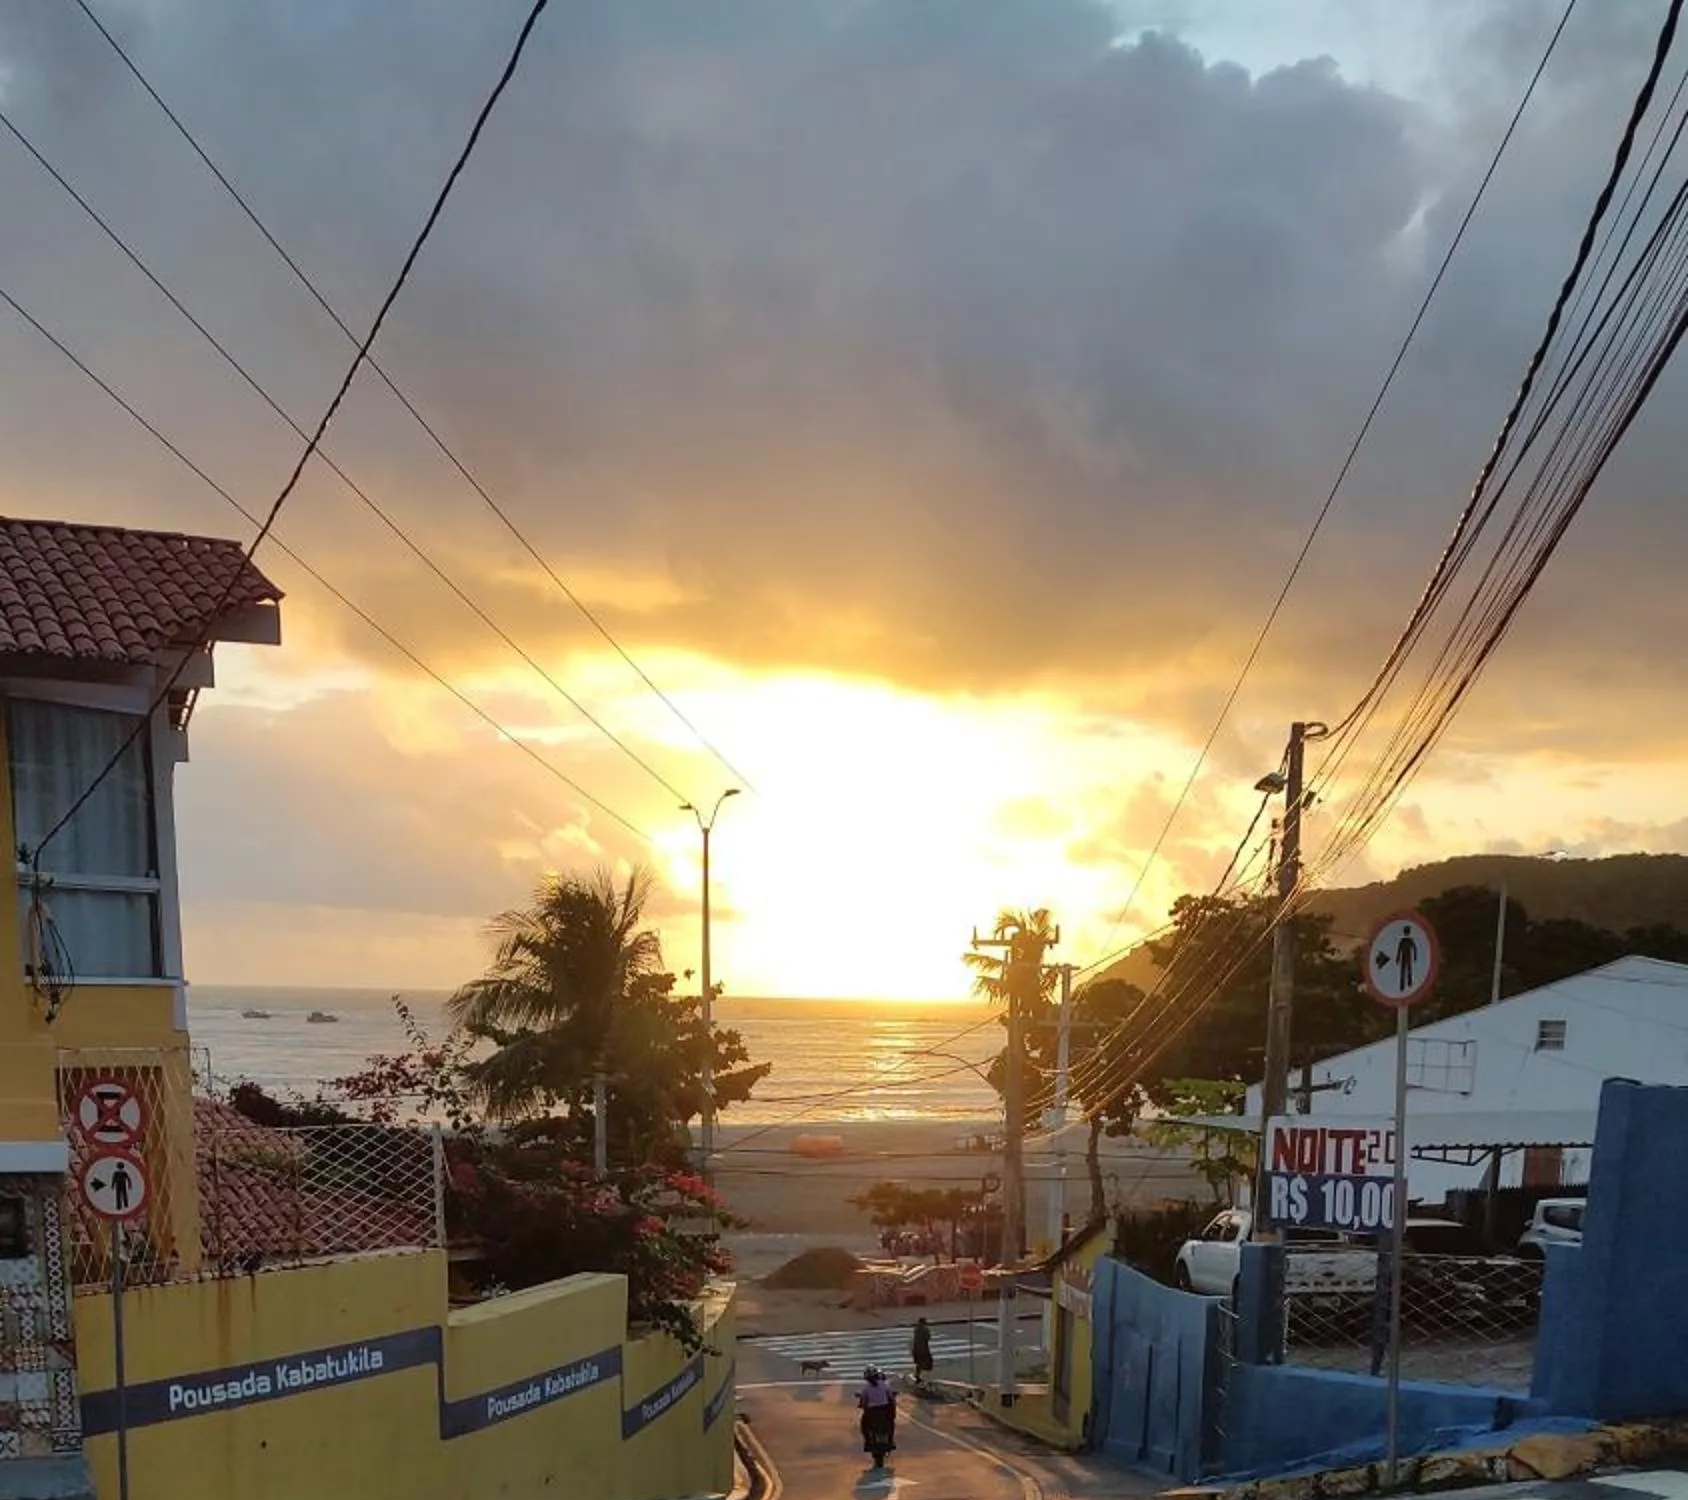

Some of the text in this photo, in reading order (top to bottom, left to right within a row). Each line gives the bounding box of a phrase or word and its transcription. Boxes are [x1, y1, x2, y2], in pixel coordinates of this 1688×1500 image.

[1273, 1127, 1367, 1175] NOITE
[1271, 1174, 1396, 1231] R$ 10,00
[168, 1346, 384, 1412] Pousada Kabatukila
[487, 1382, 542, 1420] Pousada
